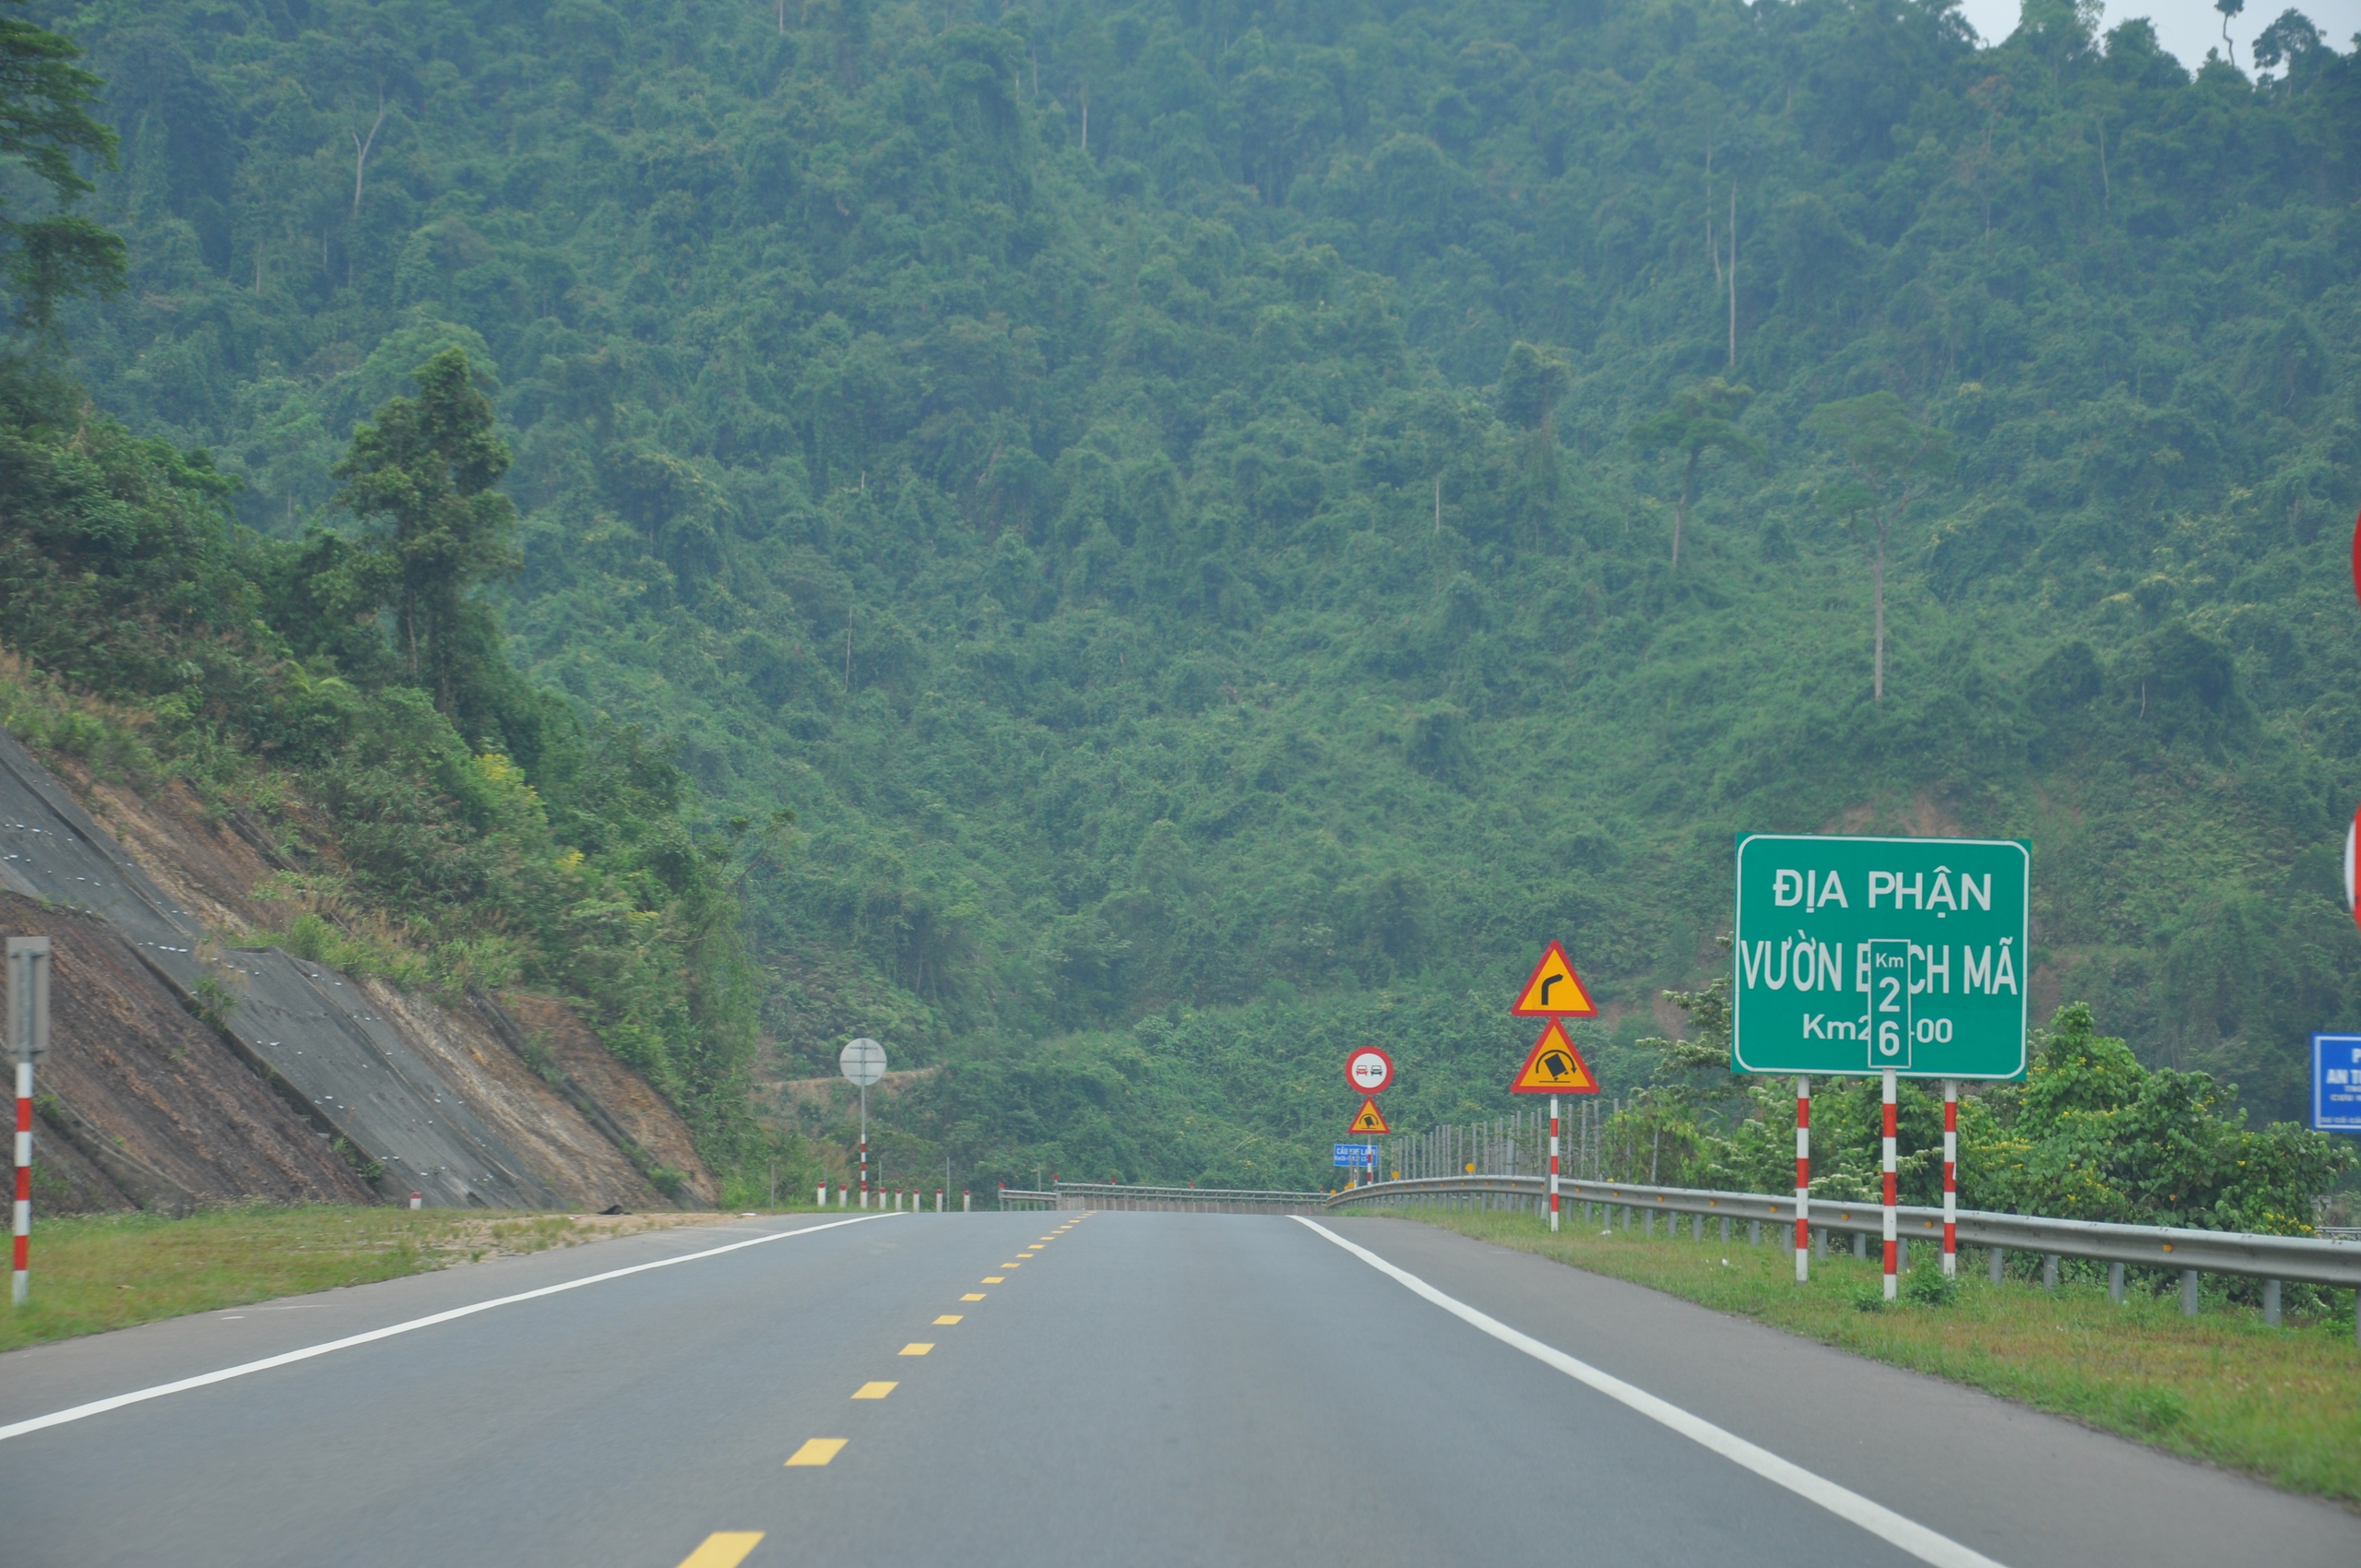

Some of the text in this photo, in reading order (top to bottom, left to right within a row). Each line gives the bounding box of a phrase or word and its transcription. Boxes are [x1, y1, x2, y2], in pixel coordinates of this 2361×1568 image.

[1773, 865, 1991, 919] ĐỊA PHẬN
[1740, 930, 1843, 992] VƯỜN
[1964, 936, 2018, 995] MÃ
[1875, 952, 1904, 968] Km
